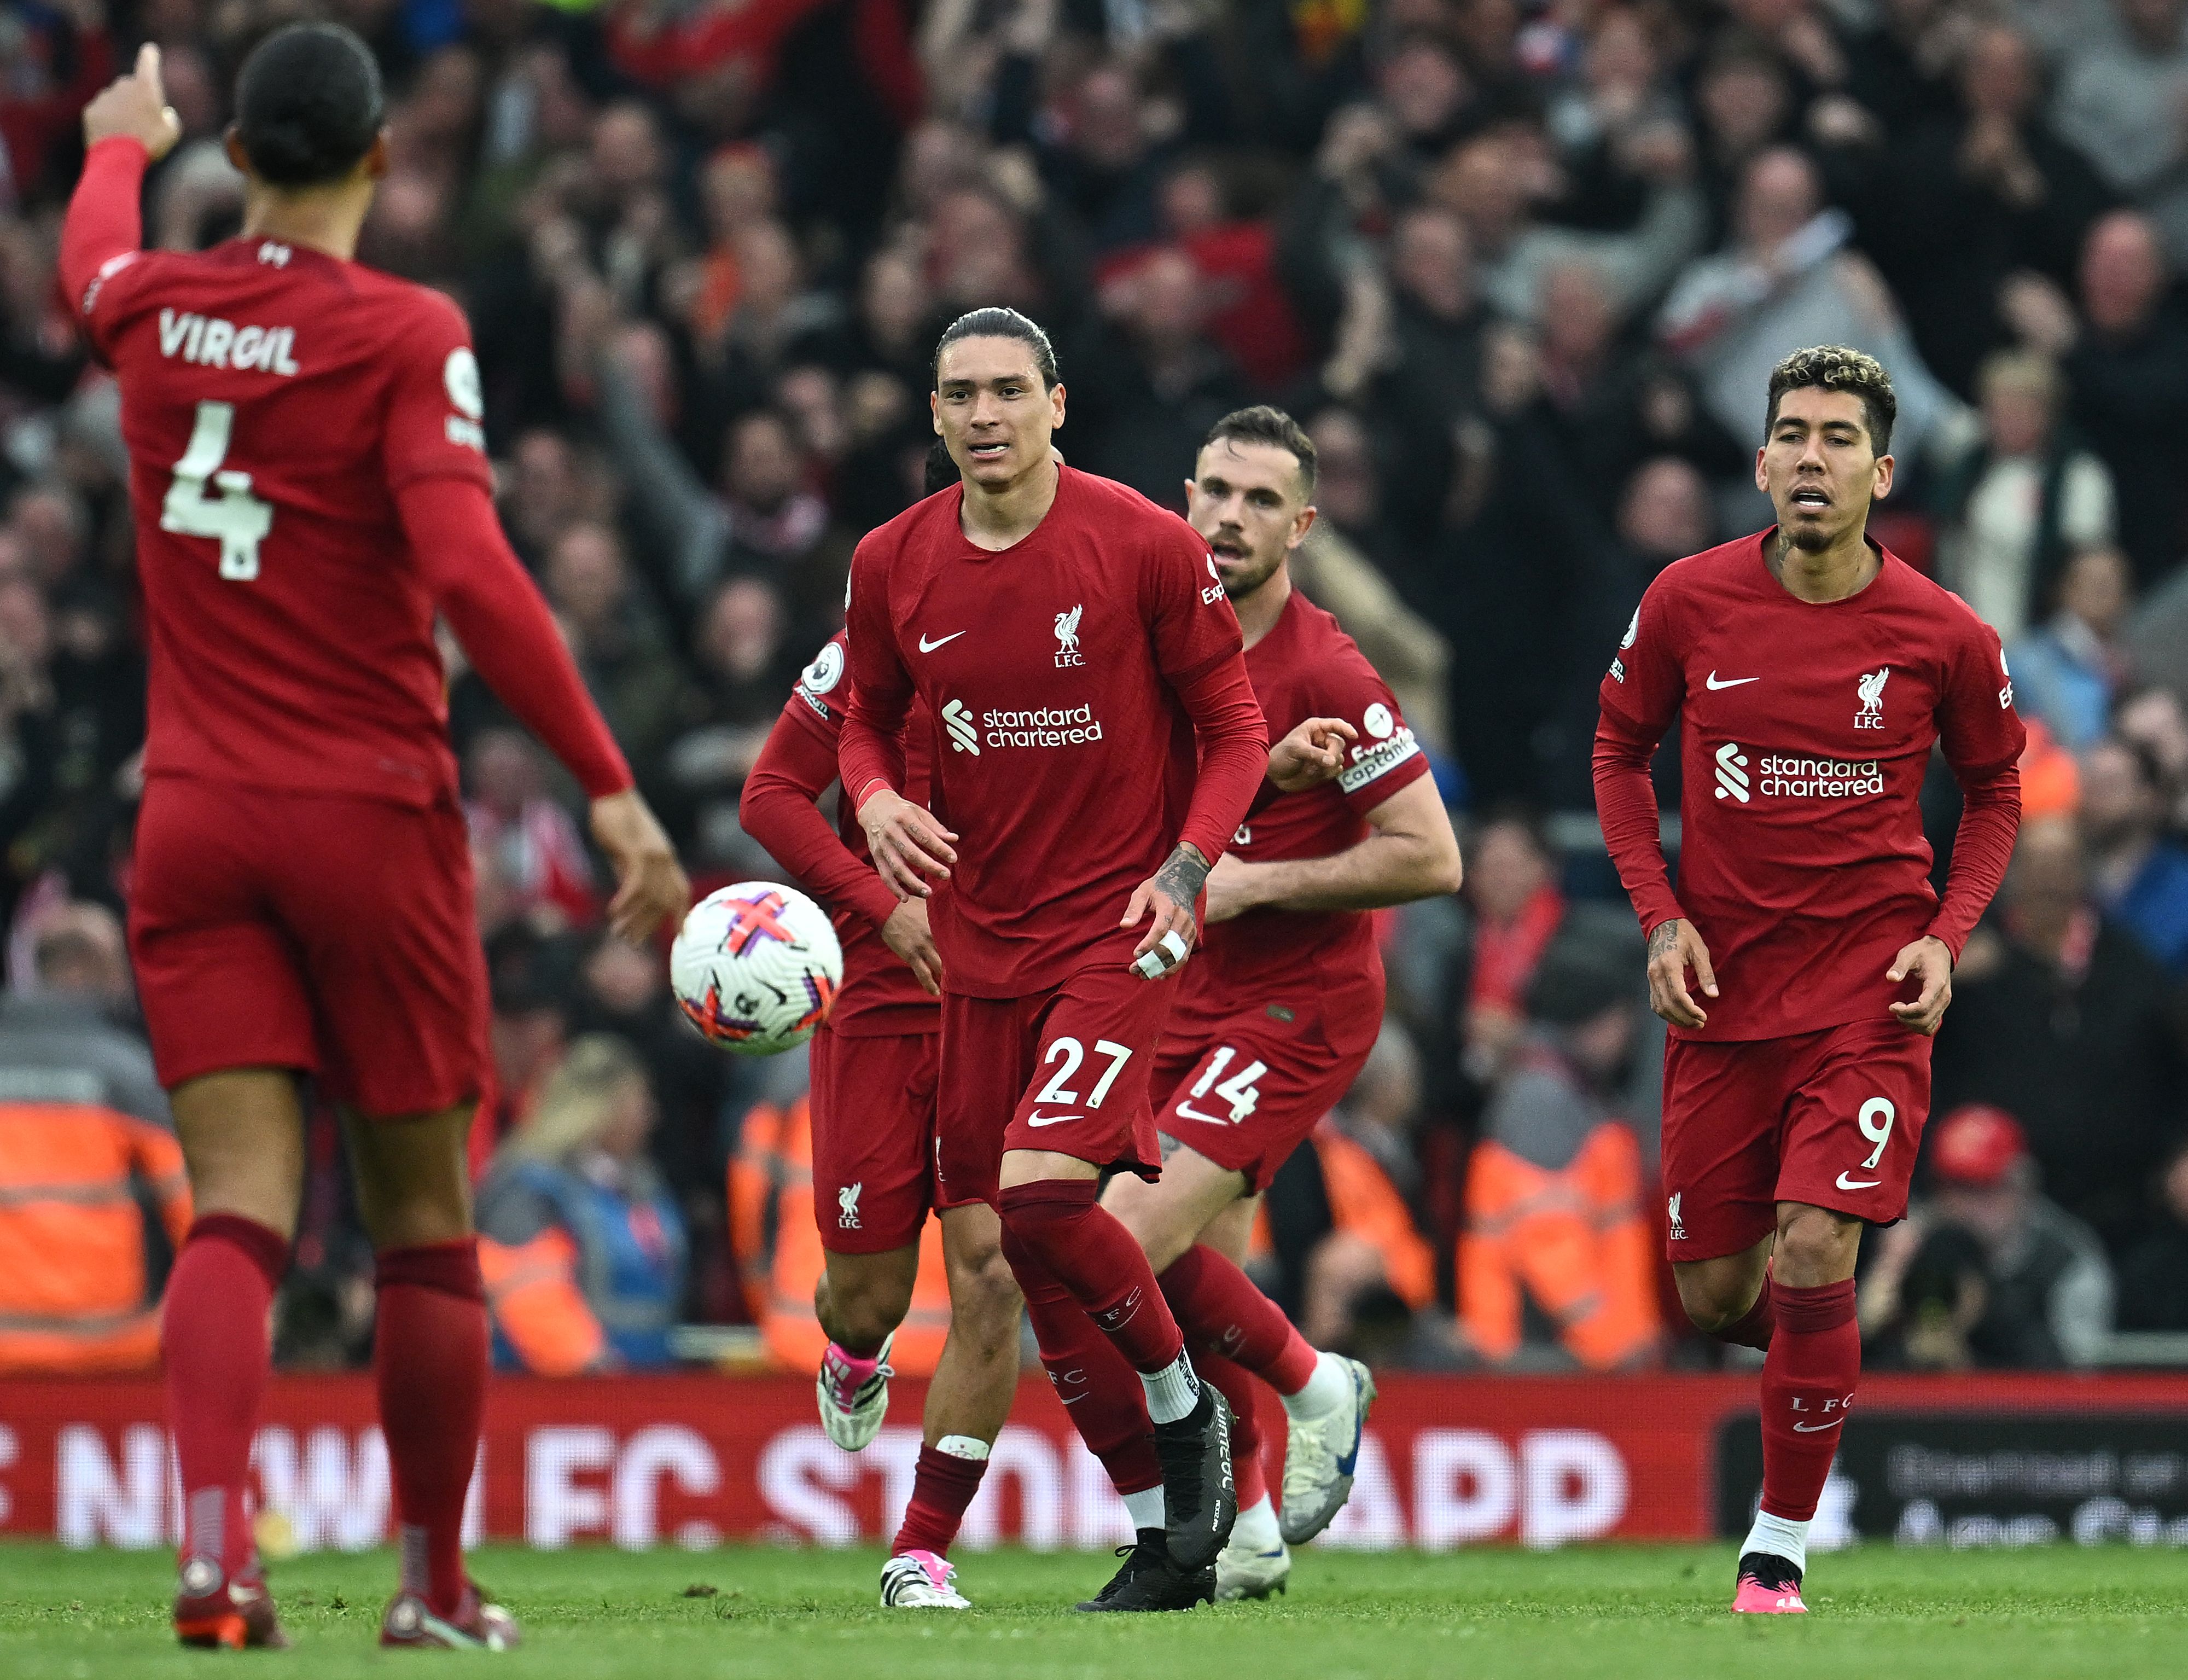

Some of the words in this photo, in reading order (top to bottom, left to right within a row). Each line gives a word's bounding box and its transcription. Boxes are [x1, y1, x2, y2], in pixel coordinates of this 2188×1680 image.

[160, 308, 299, 377] VIRGIL
[160, 400, 272, 581] 4
[983, 703, 1091, 728] standard
[987, 721, 1103, 747] chartered
[1760, 754, 1877, 777] standard
[1760, 774, 1883, 797] chartered
[1034, 1037, 1133, 1109] 27
[1190, 1047, 1268, 1124] 14
[1858, 1097, 1895, 1169] 9
[56, 1424, 392, 1551] NW
